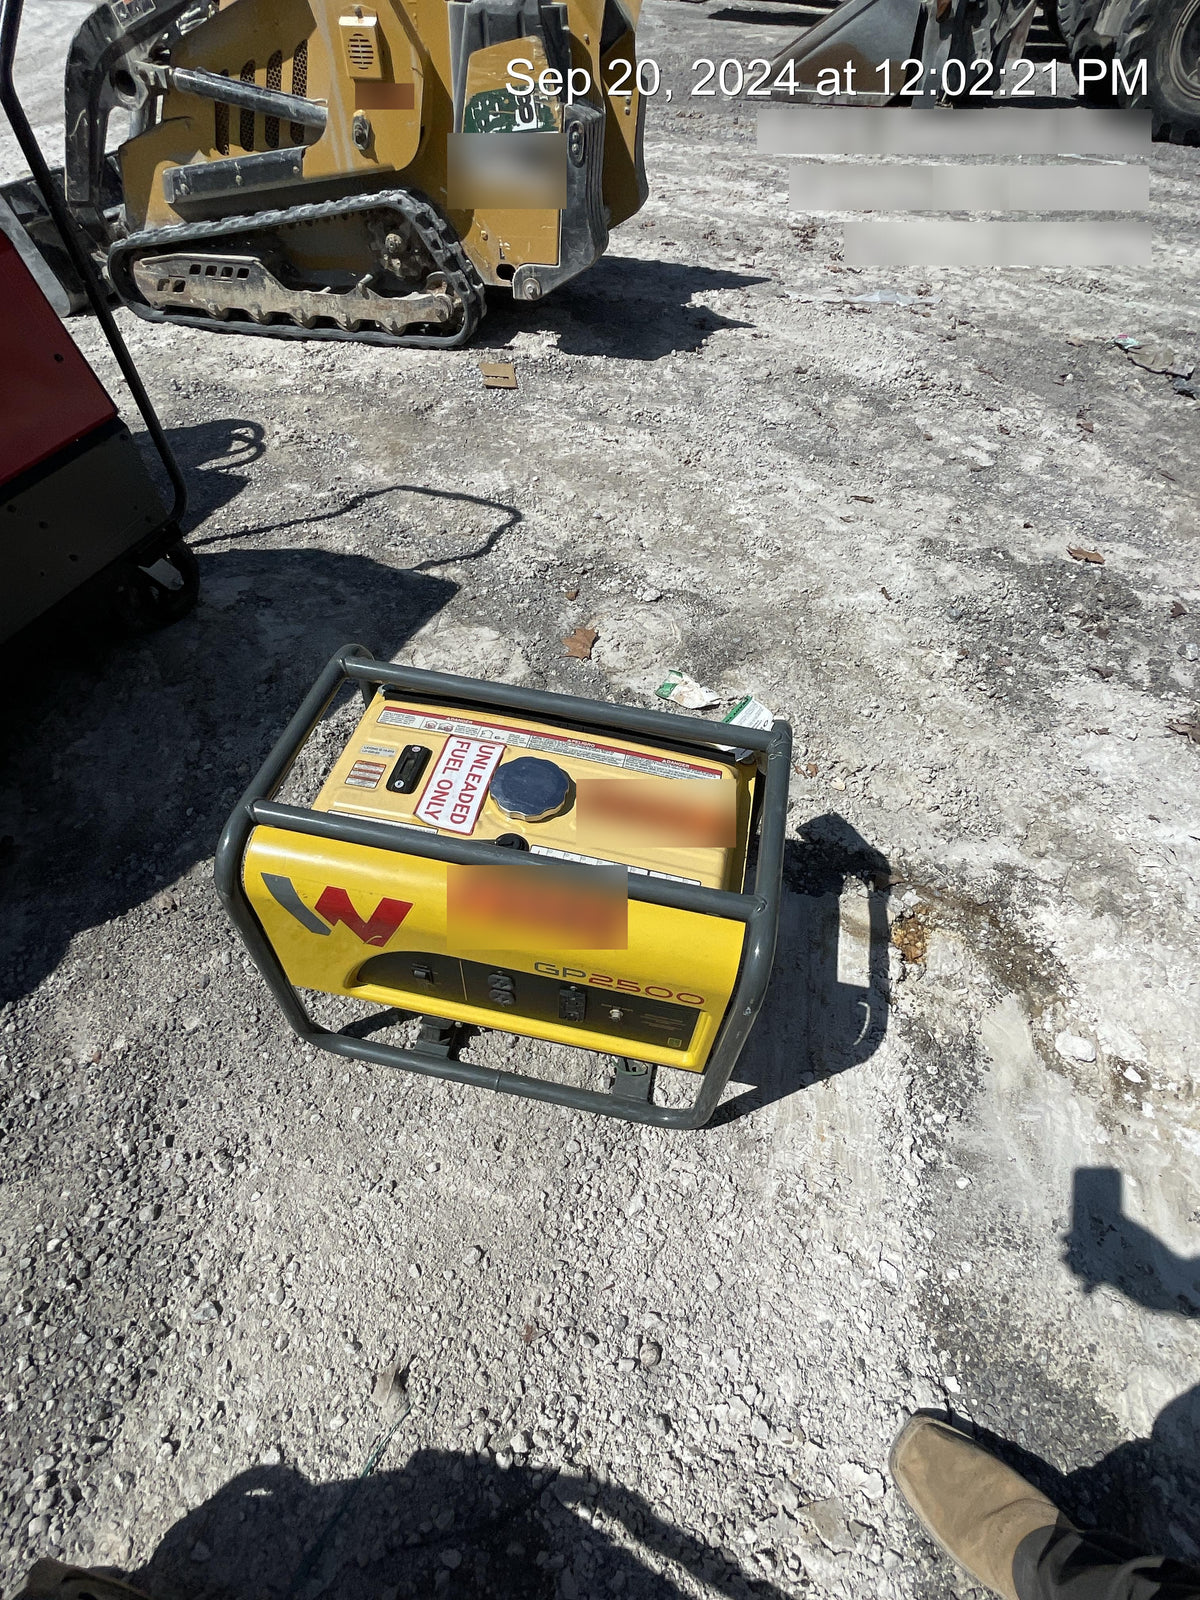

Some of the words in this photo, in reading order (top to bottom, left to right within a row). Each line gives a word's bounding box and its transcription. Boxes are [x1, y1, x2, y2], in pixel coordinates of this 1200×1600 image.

[442, 740, 471, 774] FUEL
[424, 779, 453, 820] ONLY
[450, 745, 495, 824] UNLEADED
[534, 961, 705, 1005] GP2500
